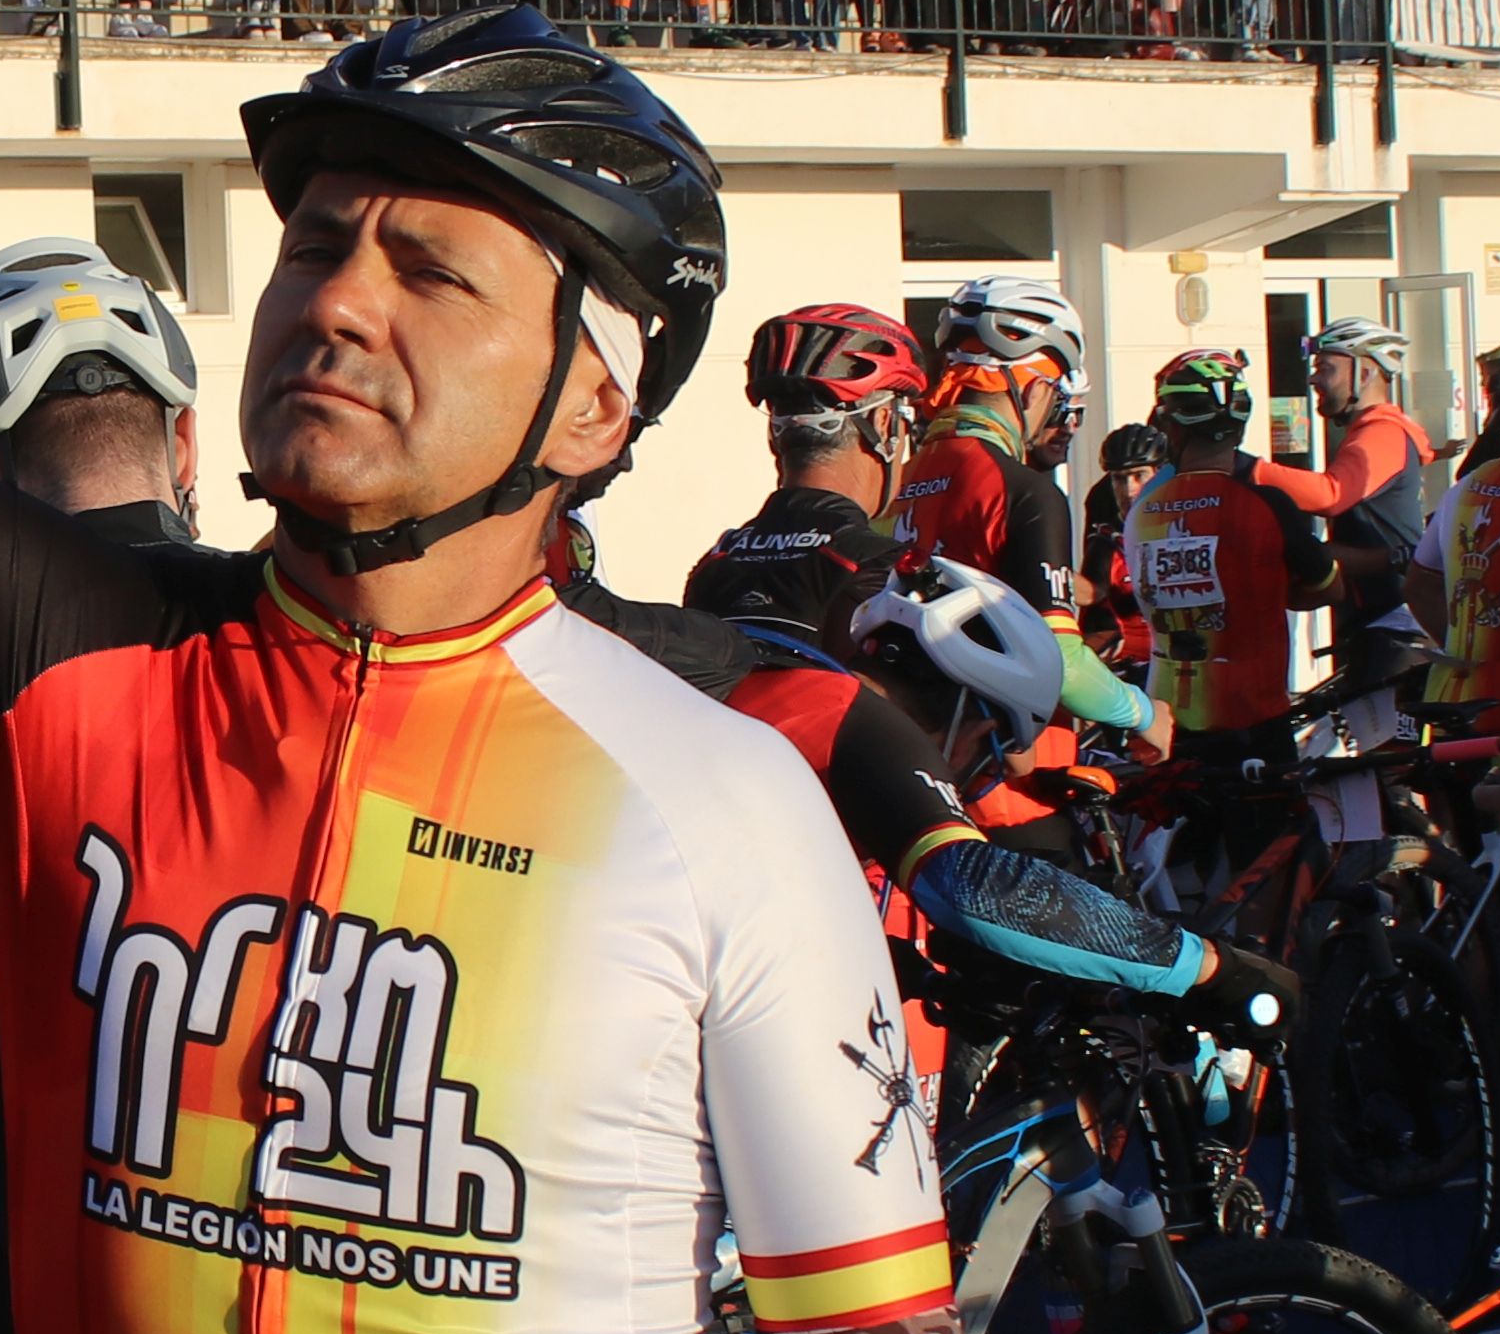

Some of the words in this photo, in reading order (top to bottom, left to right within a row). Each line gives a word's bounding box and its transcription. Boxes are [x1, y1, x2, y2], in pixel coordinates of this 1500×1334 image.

[84, 1174, 129, 1225] LA
[139, 1193, 288, 1263] LEGIÓN
[302, 1235, 397, 1282] NOS
[412, 1252, 515, 1297] UNE
